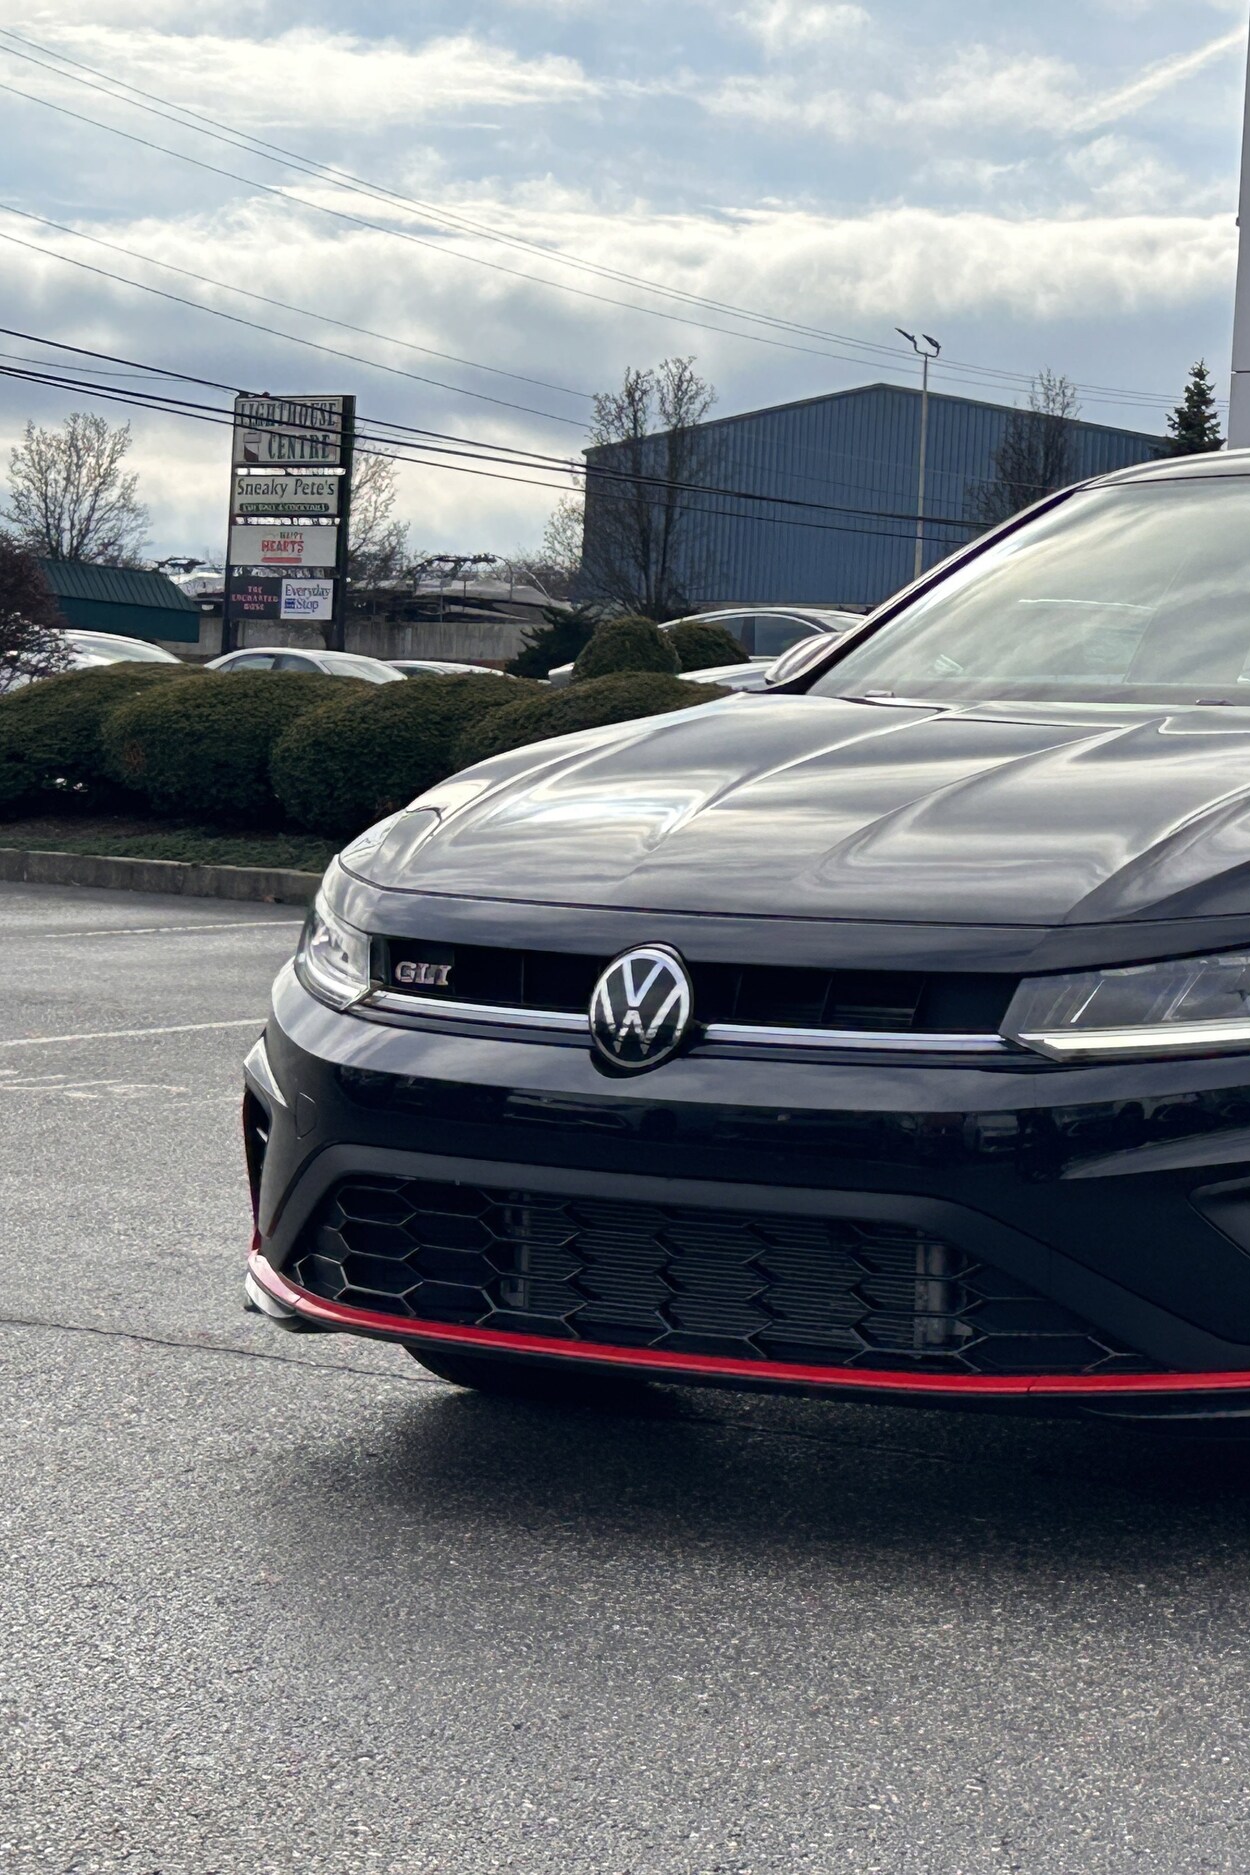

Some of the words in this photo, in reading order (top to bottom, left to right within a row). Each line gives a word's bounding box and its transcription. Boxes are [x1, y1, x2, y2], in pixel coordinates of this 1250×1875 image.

[268, 432, 331, 459] CENTRE
[237, 478, 288, 499] Sneaky
[294, 478, 335, 496] Pete's
[261, 539, 305, 554] HEARTS
[285, 583, 331, 600] Everyday
[296, 598, 319, 613] Stop
[395, 960, 453, 986] GLI
